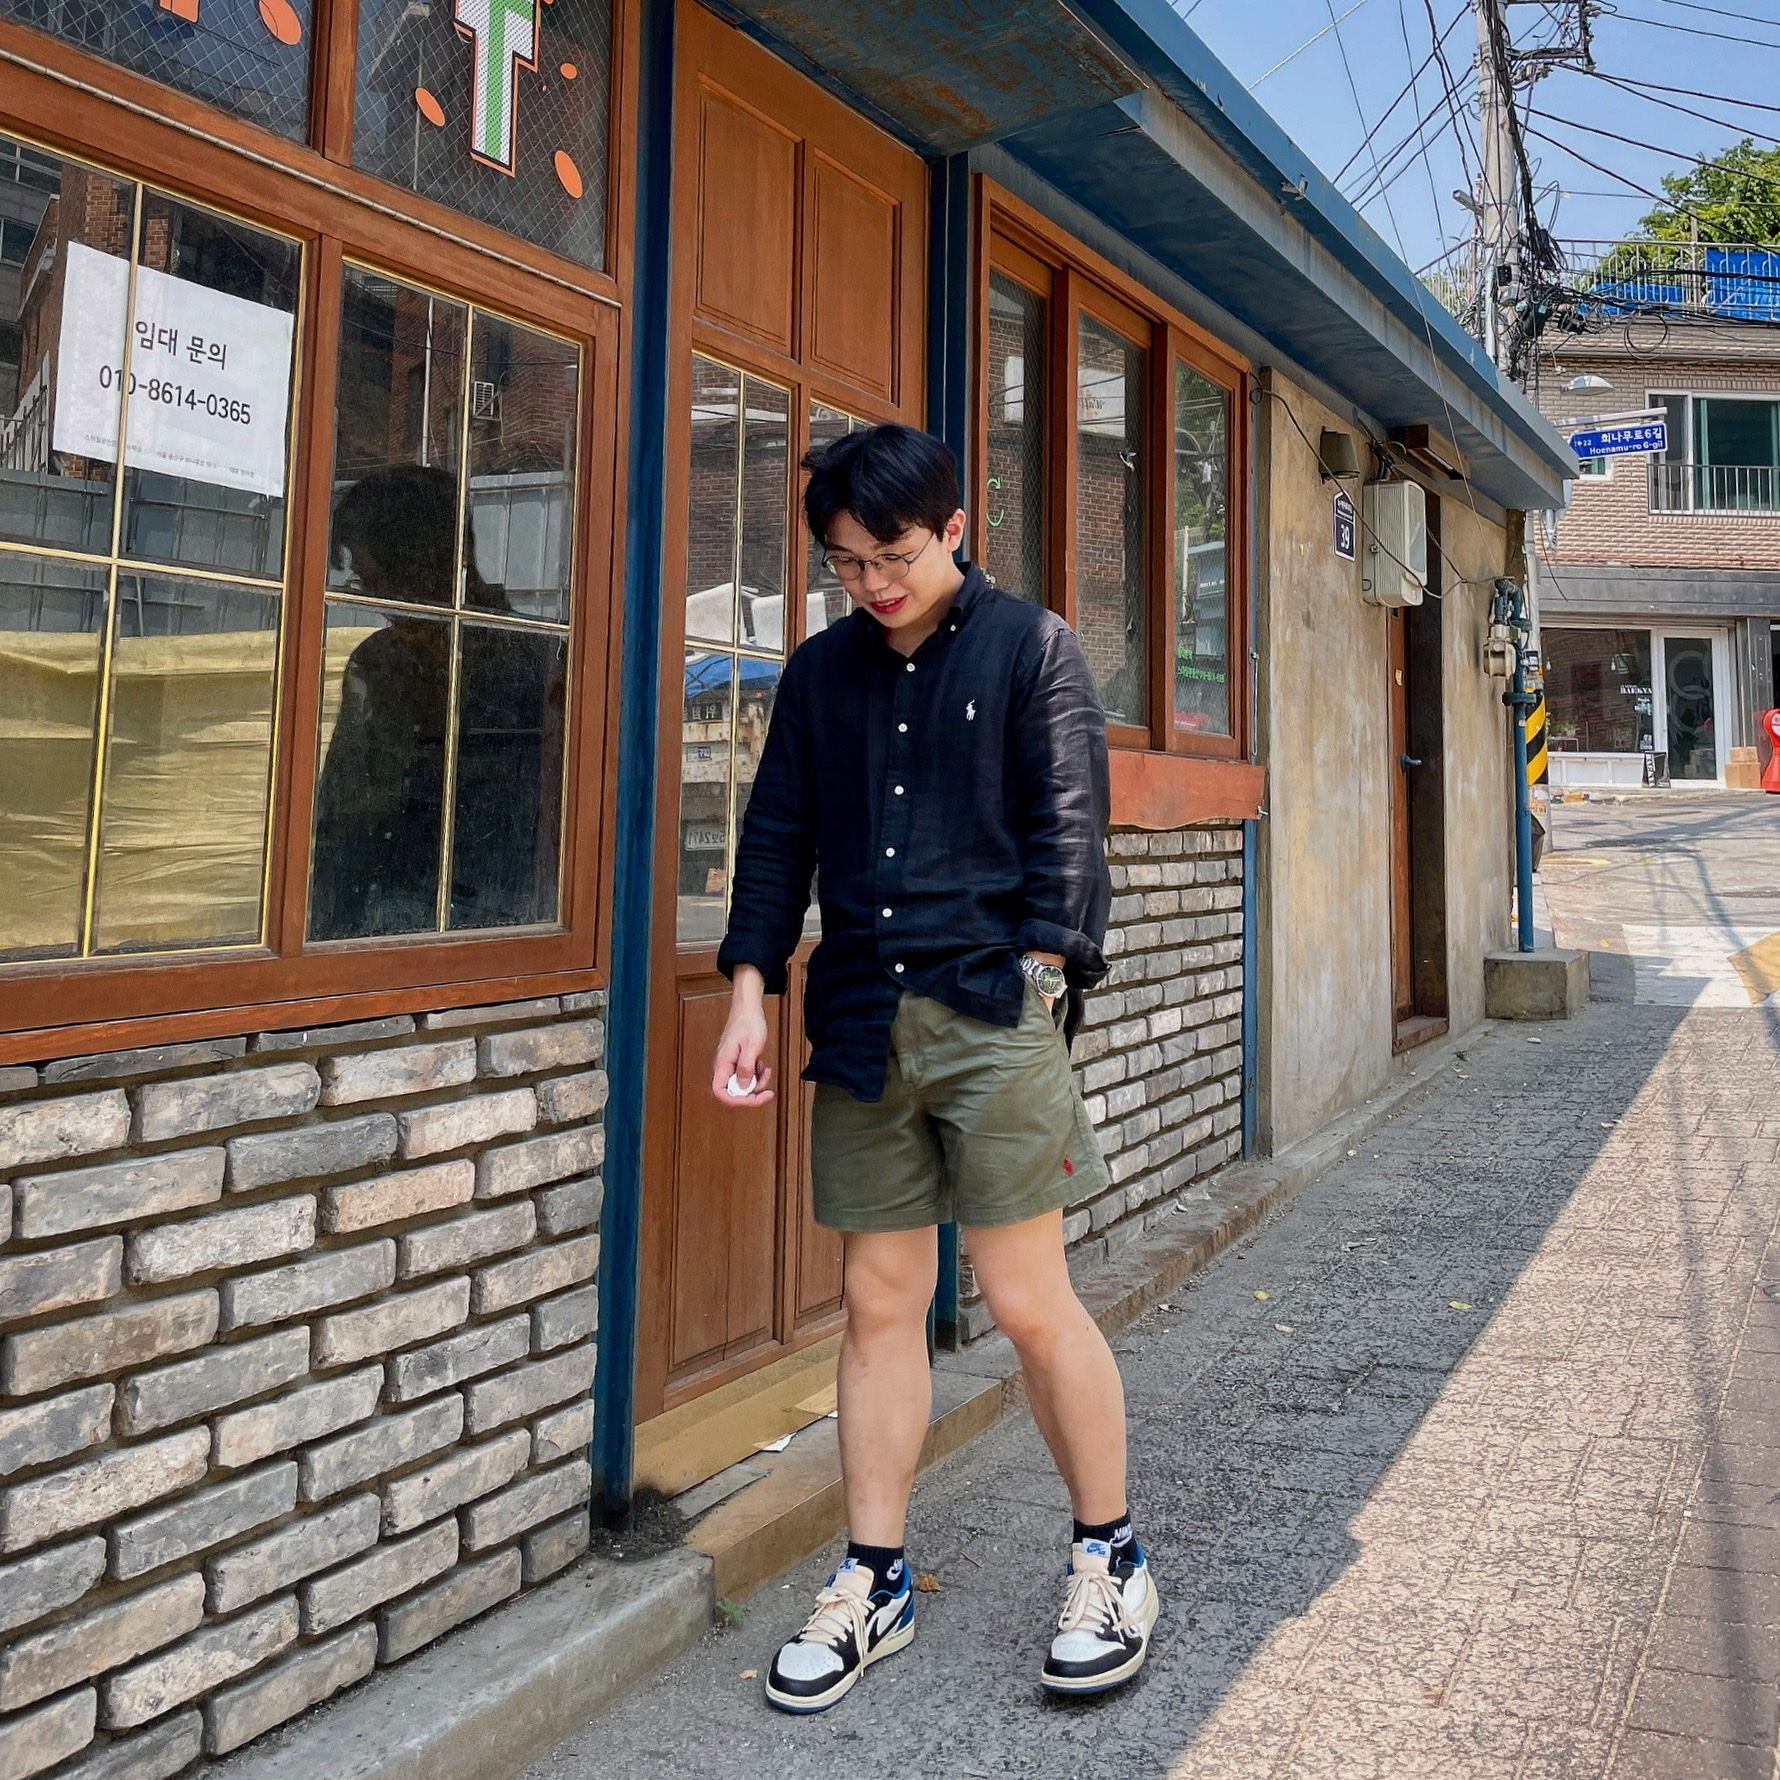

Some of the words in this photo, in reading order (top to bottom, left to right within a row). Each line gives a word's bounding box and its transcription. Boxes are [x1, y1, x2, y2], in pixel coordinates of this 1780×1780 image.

[136, 321, 178, 356] 임대
[186, 335, 227, 370] 문의
[99, 365, 251, 425] 010-8614-0365
[1589, 444, 1642, 455] Hoenamu-ro
[1643, 441, 1663, 449] 6-gil
[1601, 427, 1662, 444] 회나무로6길
[1341, 524, 1350, 549] 39
